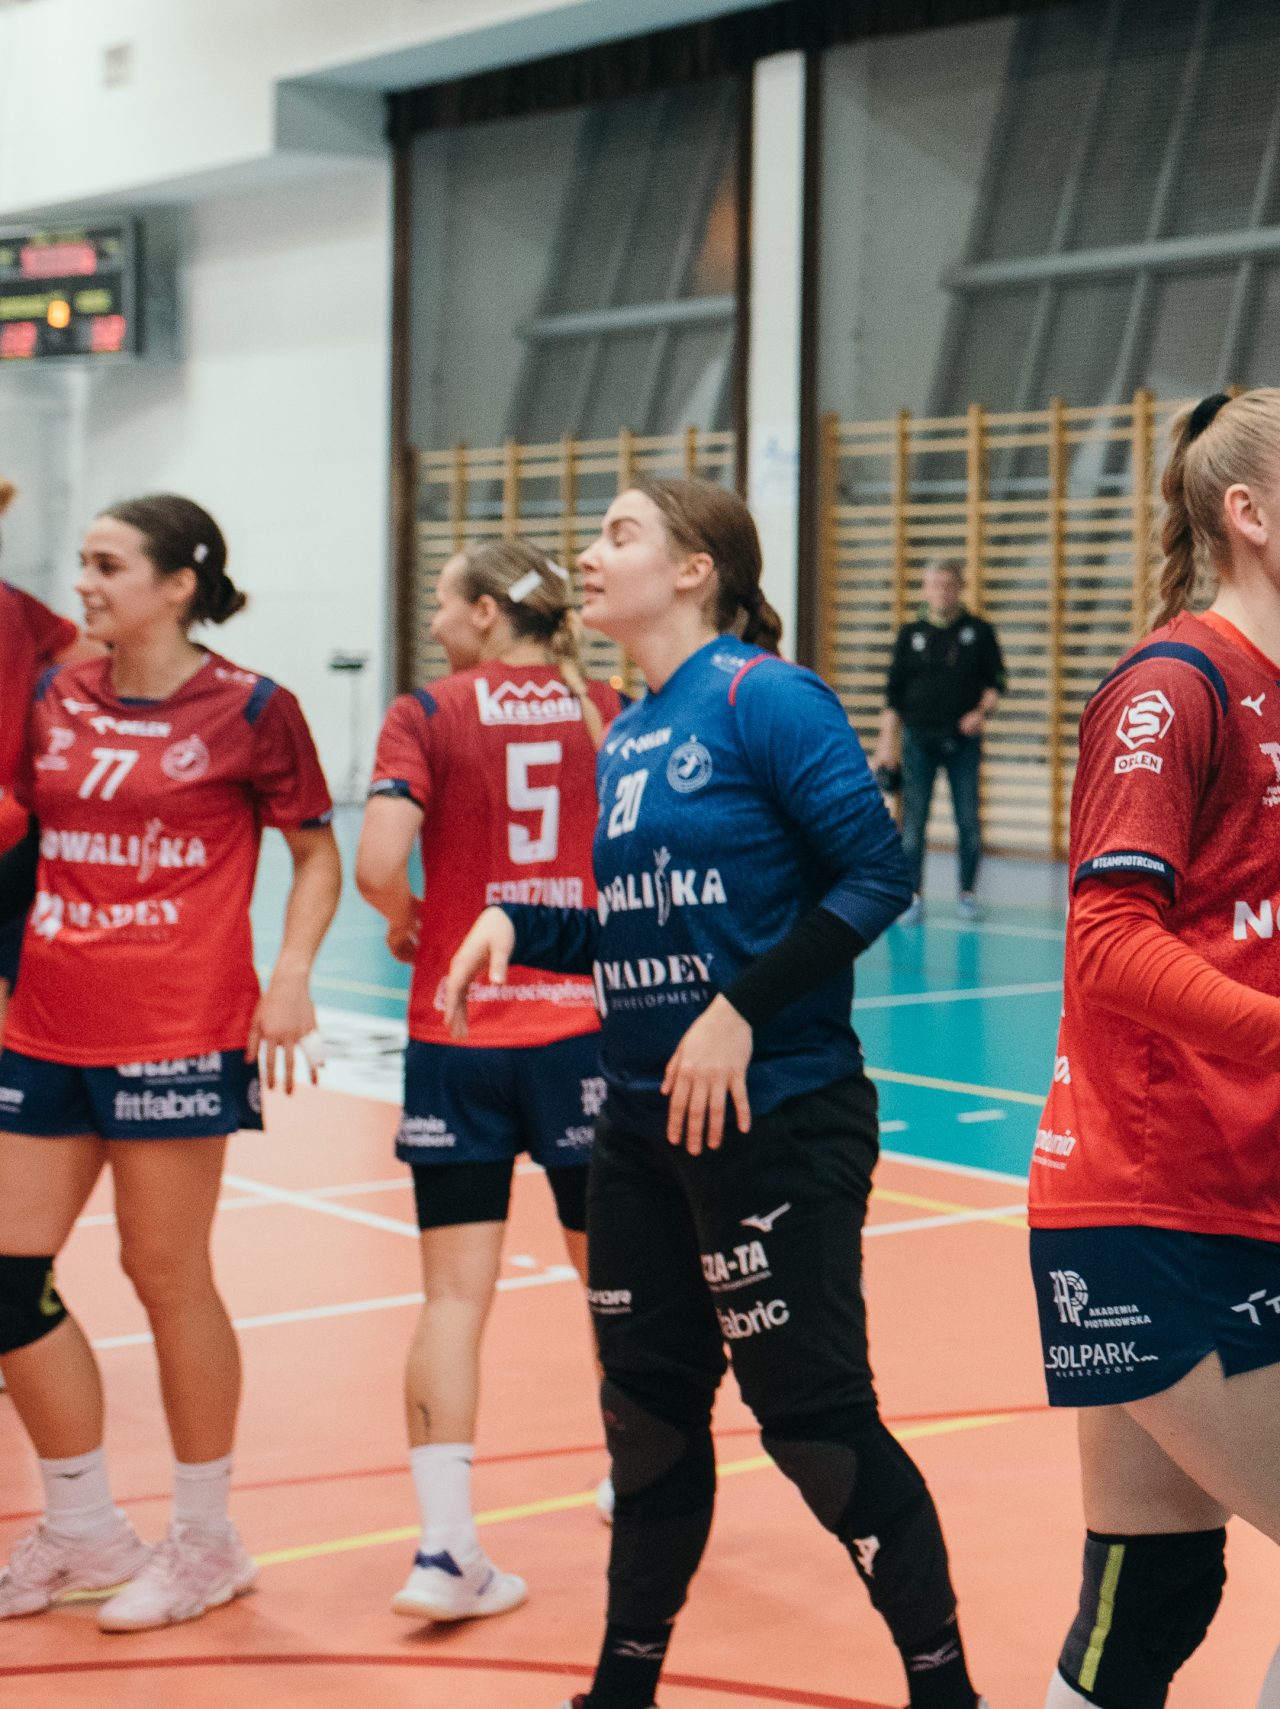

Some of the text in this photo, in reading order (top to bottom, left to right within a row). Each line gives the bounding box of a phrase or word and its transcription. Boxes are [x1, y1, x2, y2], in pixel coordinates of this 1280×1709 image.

[78, 746, 141, 801] 77
[505, 740, 563, 866] 5
[607, 768, 650, 841] 20
[1083, 1314, 1153, 1330] PIOTRKOWSKA
[1088, 1303, 1140, 1317] AKADEMIA
[1044, 1341, 1141, 1370] SOLPARK
